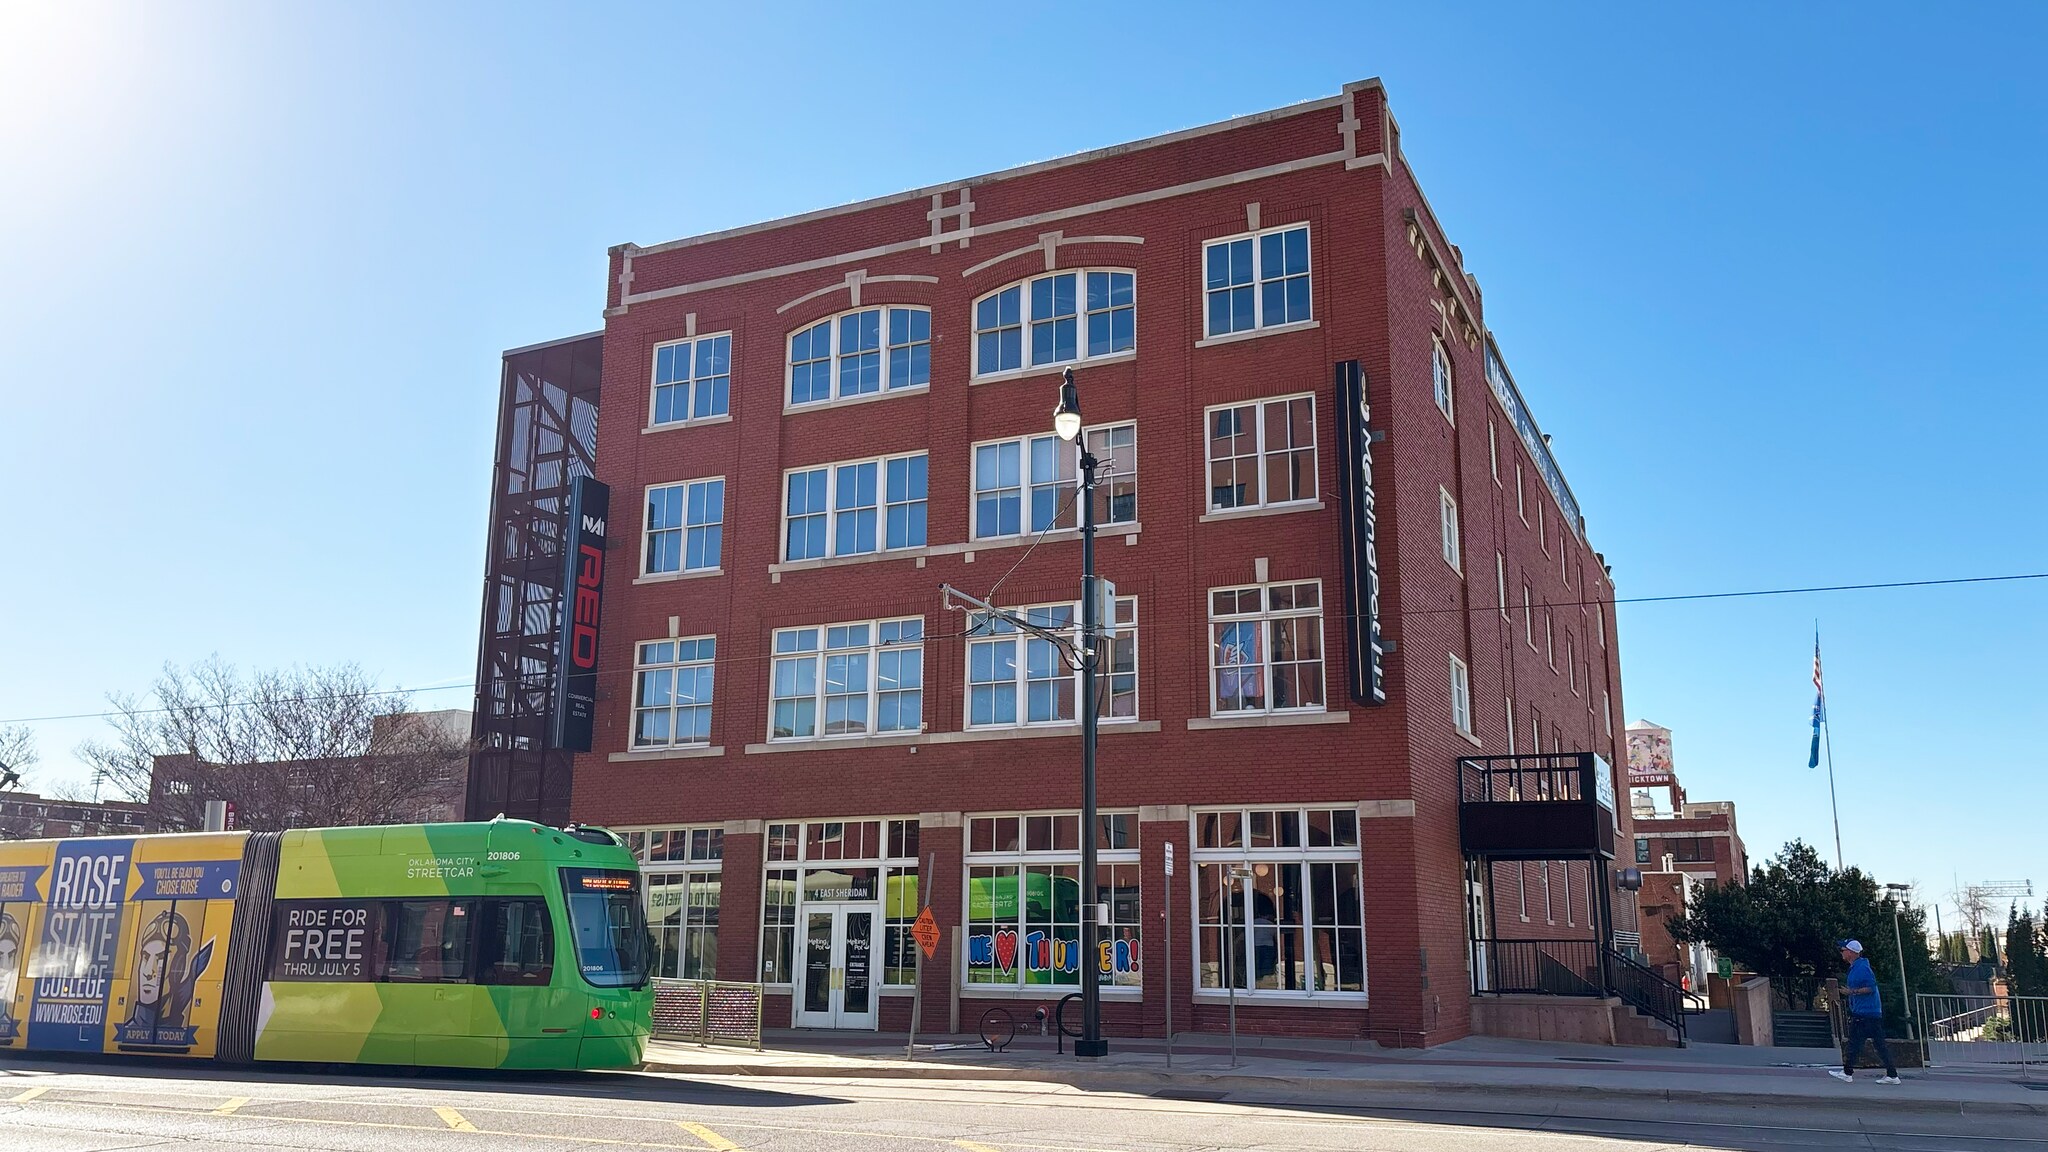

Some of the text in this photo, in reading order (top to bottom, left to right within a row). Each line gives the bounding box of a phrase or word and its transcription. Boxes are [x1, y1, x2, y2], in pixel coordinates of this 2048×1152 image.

[582, 514, 605, 537] NAI
[572, 544, 603, 669] RED
[1629, 775, 1669, 783] ICKTOWN
[408, 857, 475, 867] OKLAHOMA CITY
[487, 851, 521, 861] 201806
[407, 867, 474, 879] STREETCAR
[53, 855, 125, 910] ROSE
[156, 879, 200, 895] CHOSE ROSE
[814, 888, 819, 898] 4
[820, 888, 835, 898] EAST
[835, 887, 868, 898] SHERIDAN
[289, 909, 367, 926] RIDE FOR
[46, 913, 115, 961] STATE
[284, 929, 365, 959] FREE
[808, 938, 827, 946] Melting
[846, 938, 866, 946] Melting
[969, 934, 992, 965] WE
[1026, 930, 1140, 974] THUNER!
[284, 963, 361, 976] THRU JULY 5
[40, 964, 108, 998] COLLEGE
[35, 1002, 102, 1025] WWW.ROSE.EDU
[126, 1030, 186, 1041] APPLY TODAY
